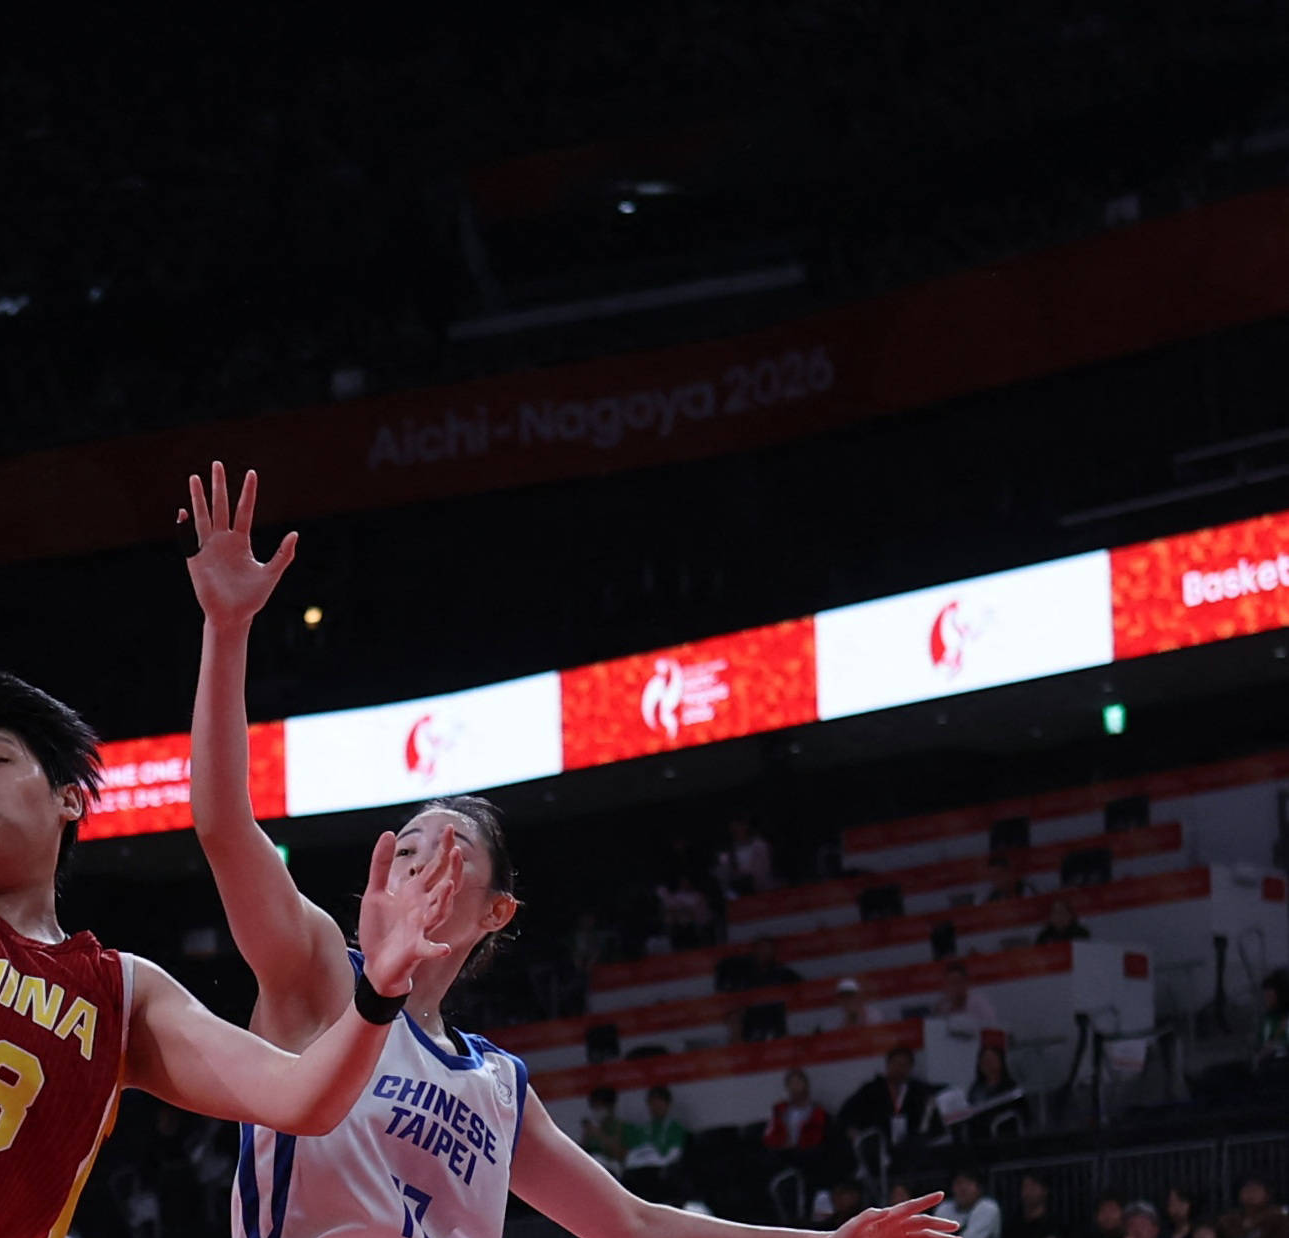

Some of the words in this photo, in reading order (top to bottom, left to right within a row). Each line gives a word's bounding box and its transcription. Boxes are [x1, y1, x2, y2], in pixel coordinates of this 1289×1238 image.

[365, 378, 717, 471] Aichi-Nagoya
[721, 343, 835, 415] 2026
[373, 1074, 497, 1165] CHINESE
[385, 1106, 478, 1187] TAIPEI
